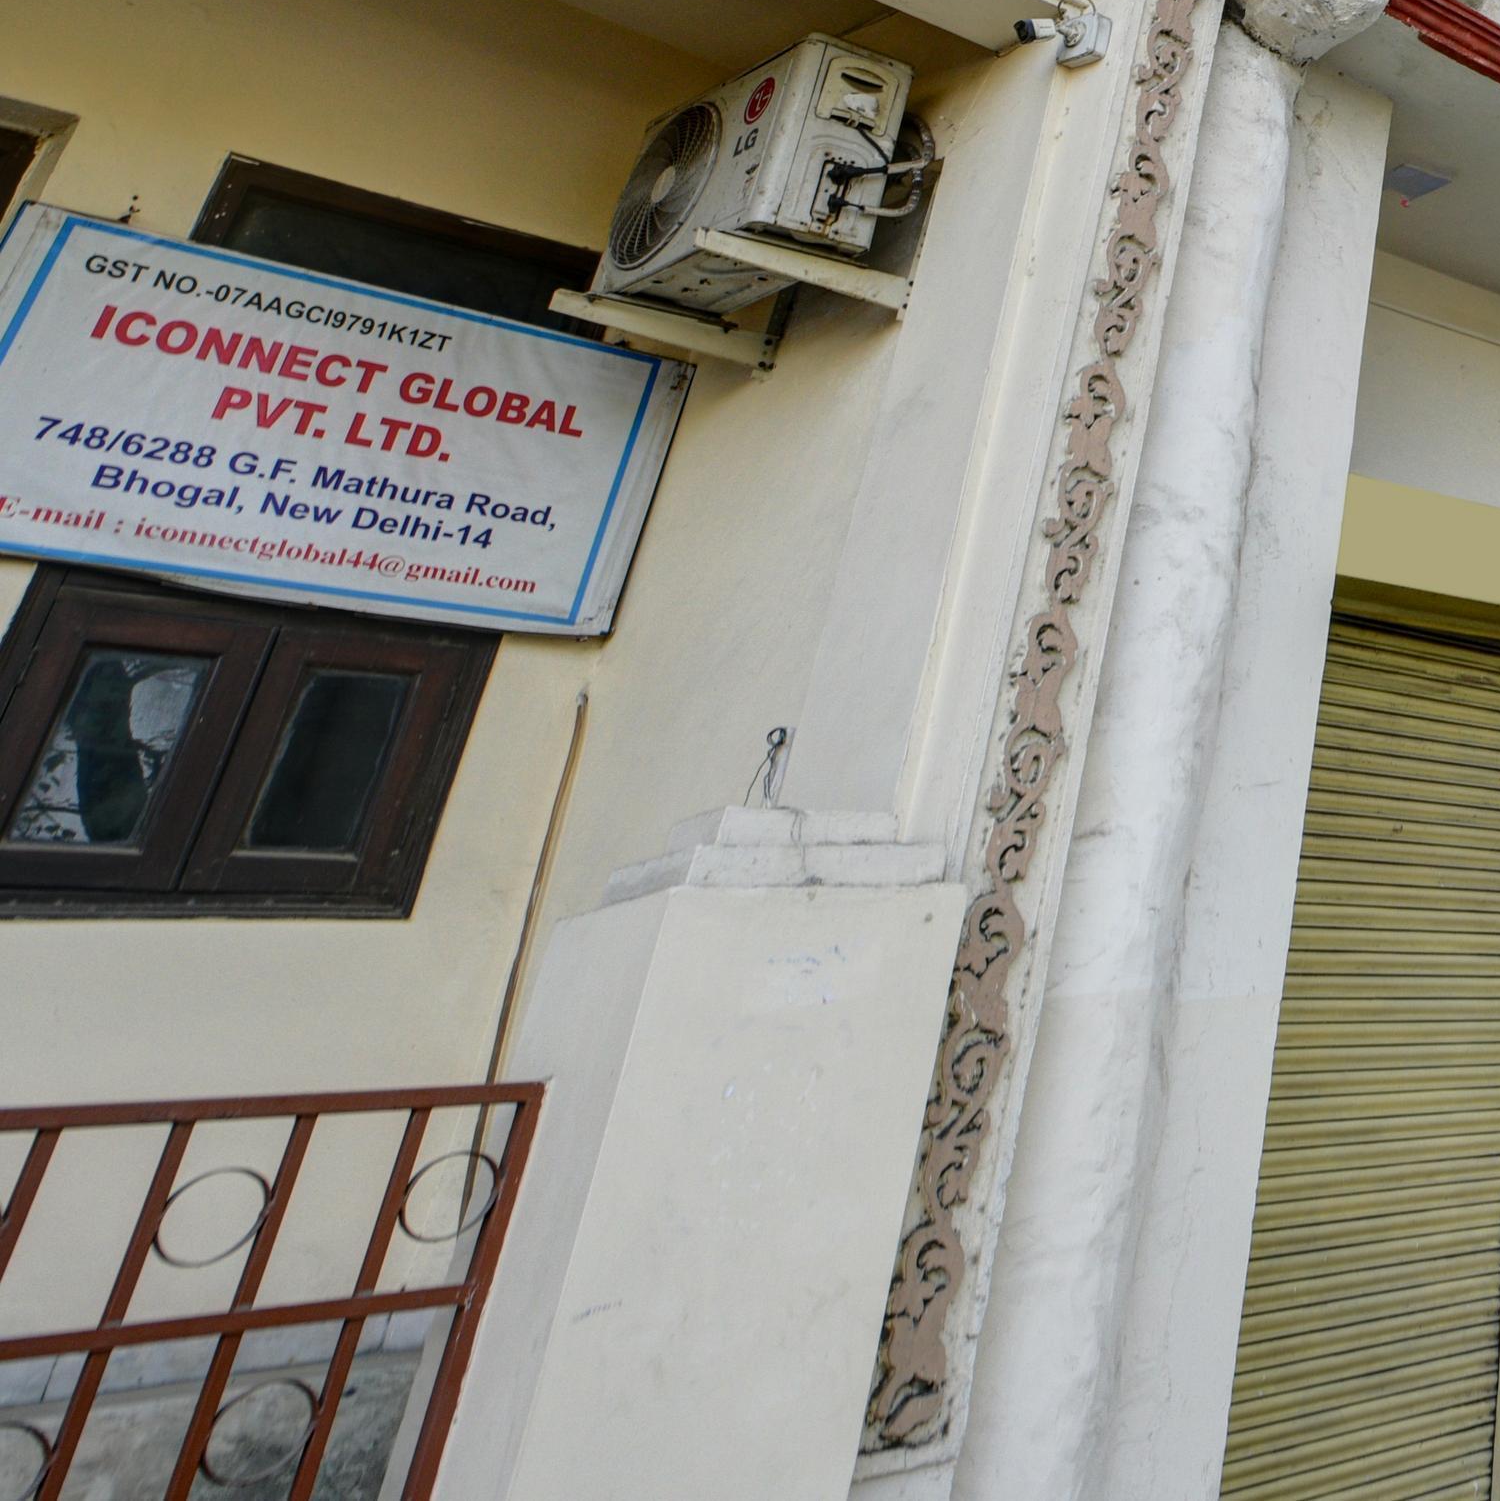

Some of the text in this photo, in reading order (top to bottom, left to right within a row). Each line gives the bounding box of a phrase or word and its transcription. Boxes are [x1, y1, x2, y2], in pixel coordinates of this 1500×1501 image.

[733, 127, 759, 157] LG
[85, 253, 149, 284] GST
[91, 304, 583, 438] ICONNECT GLOBAL
[211, 386, 451, 463] PVT. LTD.
[34, 416, 557, 533] 748/6288 G.F. Mathura Road,
[90, 464, 493, 551] Bhogal, New Delhi-14
[0, 495, 106, 531] E-mail
[134, 517, 537, 595] iconnectglobal44@gmail.com
